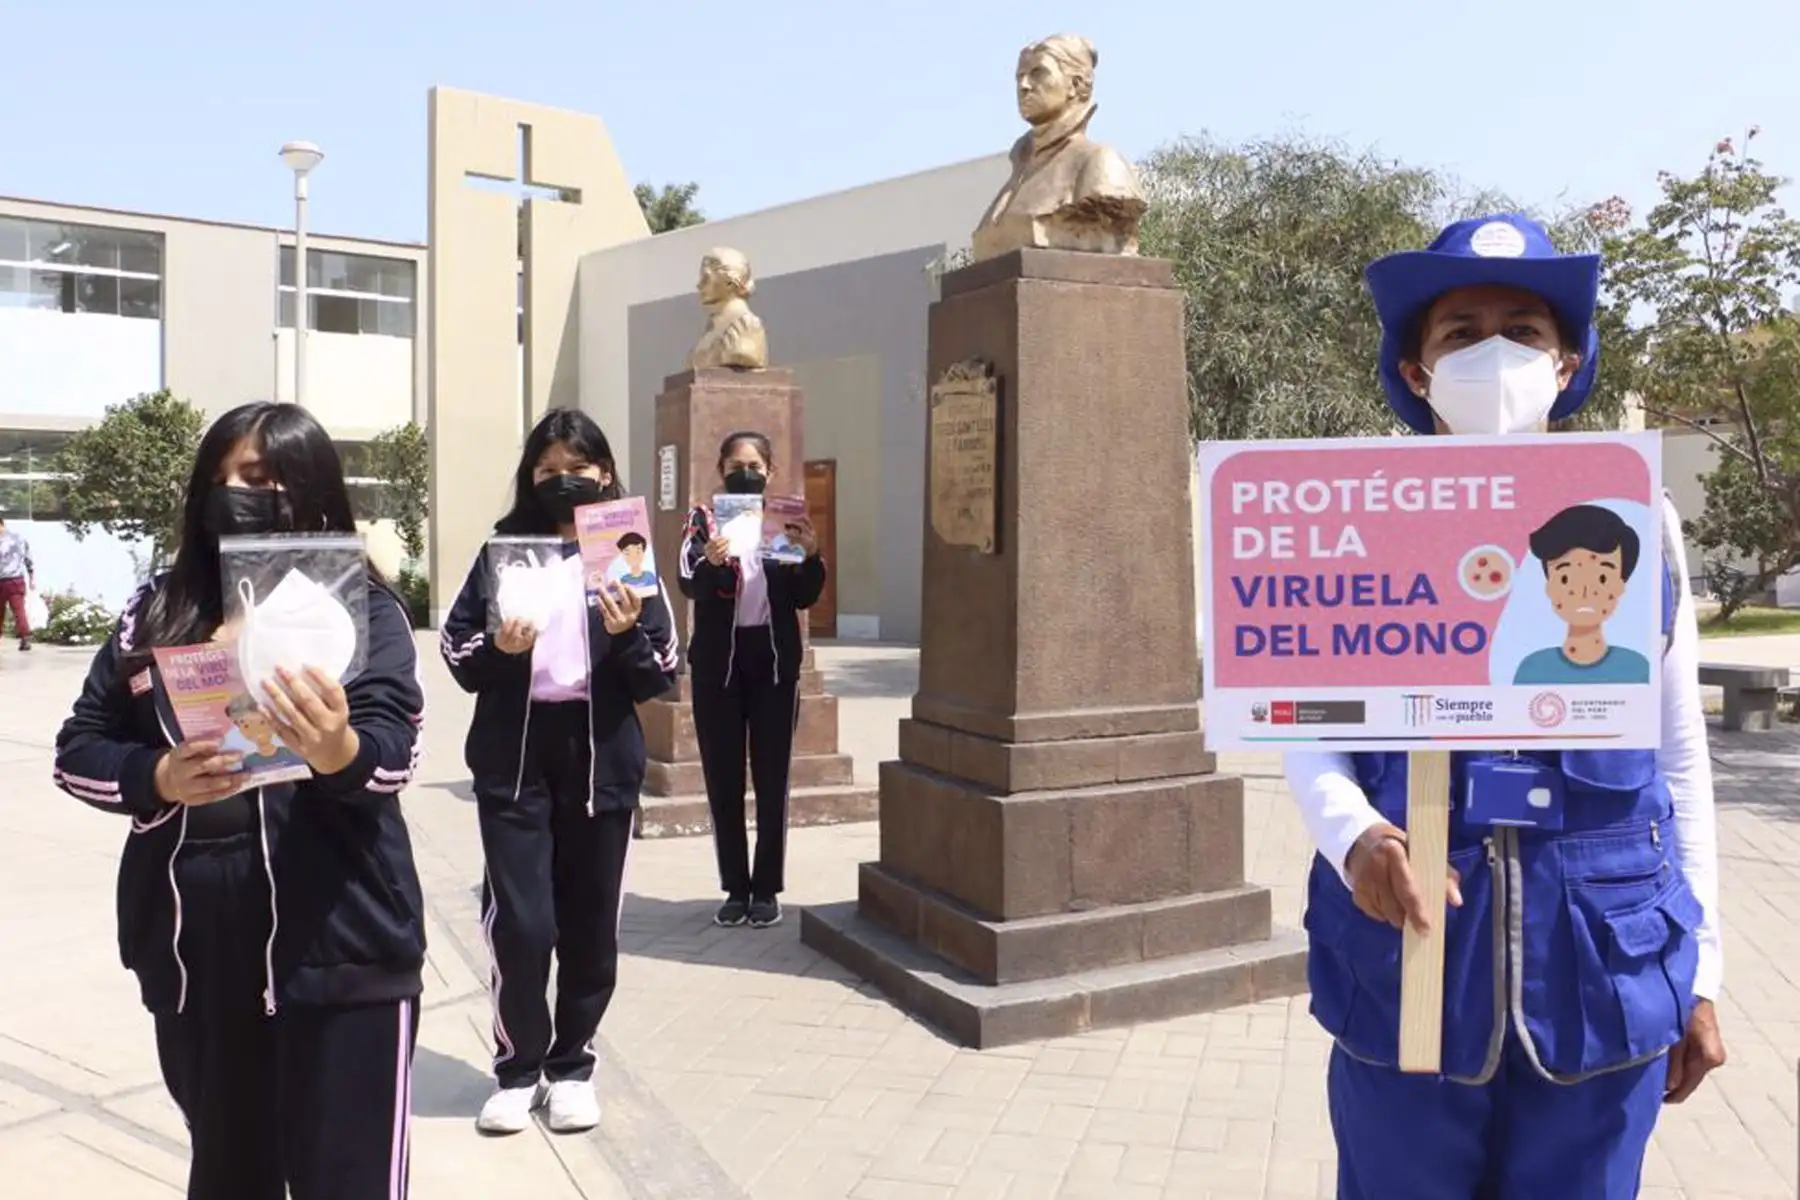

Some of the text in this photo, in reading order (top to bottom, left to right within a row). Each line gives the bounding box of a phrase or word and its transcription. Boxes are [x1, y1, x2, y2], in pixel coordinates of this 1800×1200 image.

[1231, 470, 1516, 514] PROTÉGETE
[1232, 525, 1368, 560] DE LA
[1231, 573, 1439, 608] VIRUELA
[1235, 621, 1488, 657] DEL MONO
[1435, 698, 1494, 714] Siempre
[1456, 711, 1494, 723] pueblo
